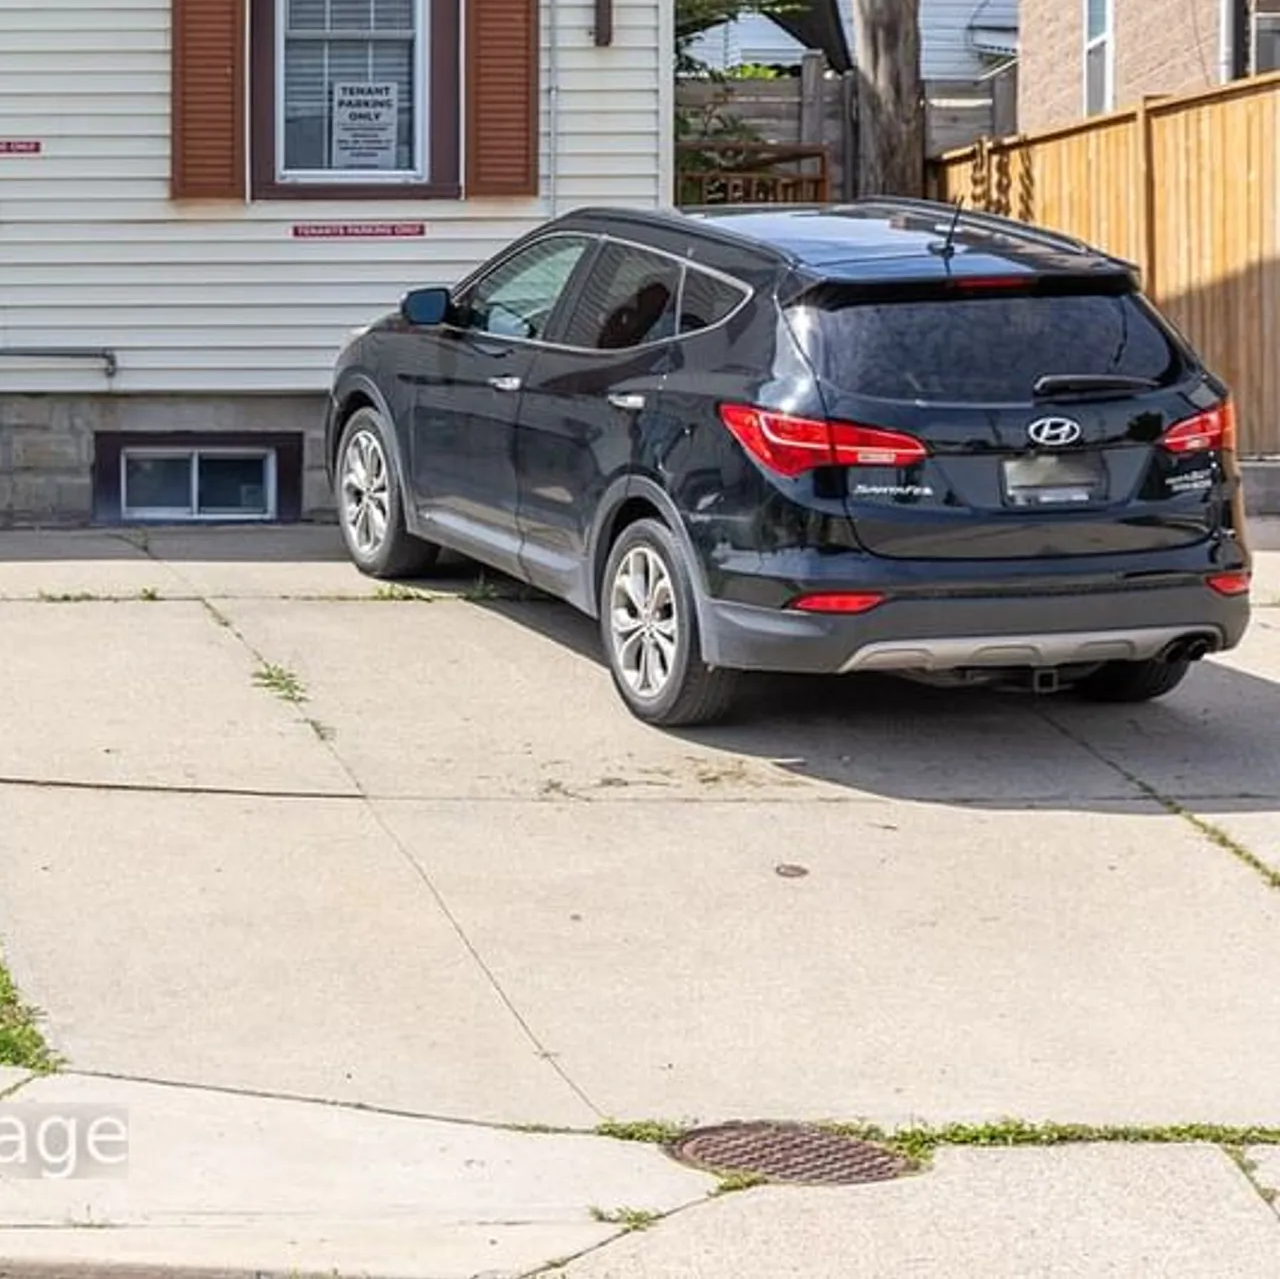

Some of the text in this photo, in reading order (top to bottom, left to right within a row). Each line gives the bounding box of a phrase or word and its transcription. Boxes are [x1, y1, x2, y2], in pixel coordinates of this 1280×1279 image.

[341, 86, 391, 97] TENANT
[338, 99, 393, 109] PARKING
[348, 112, 382, 122] ONLY
